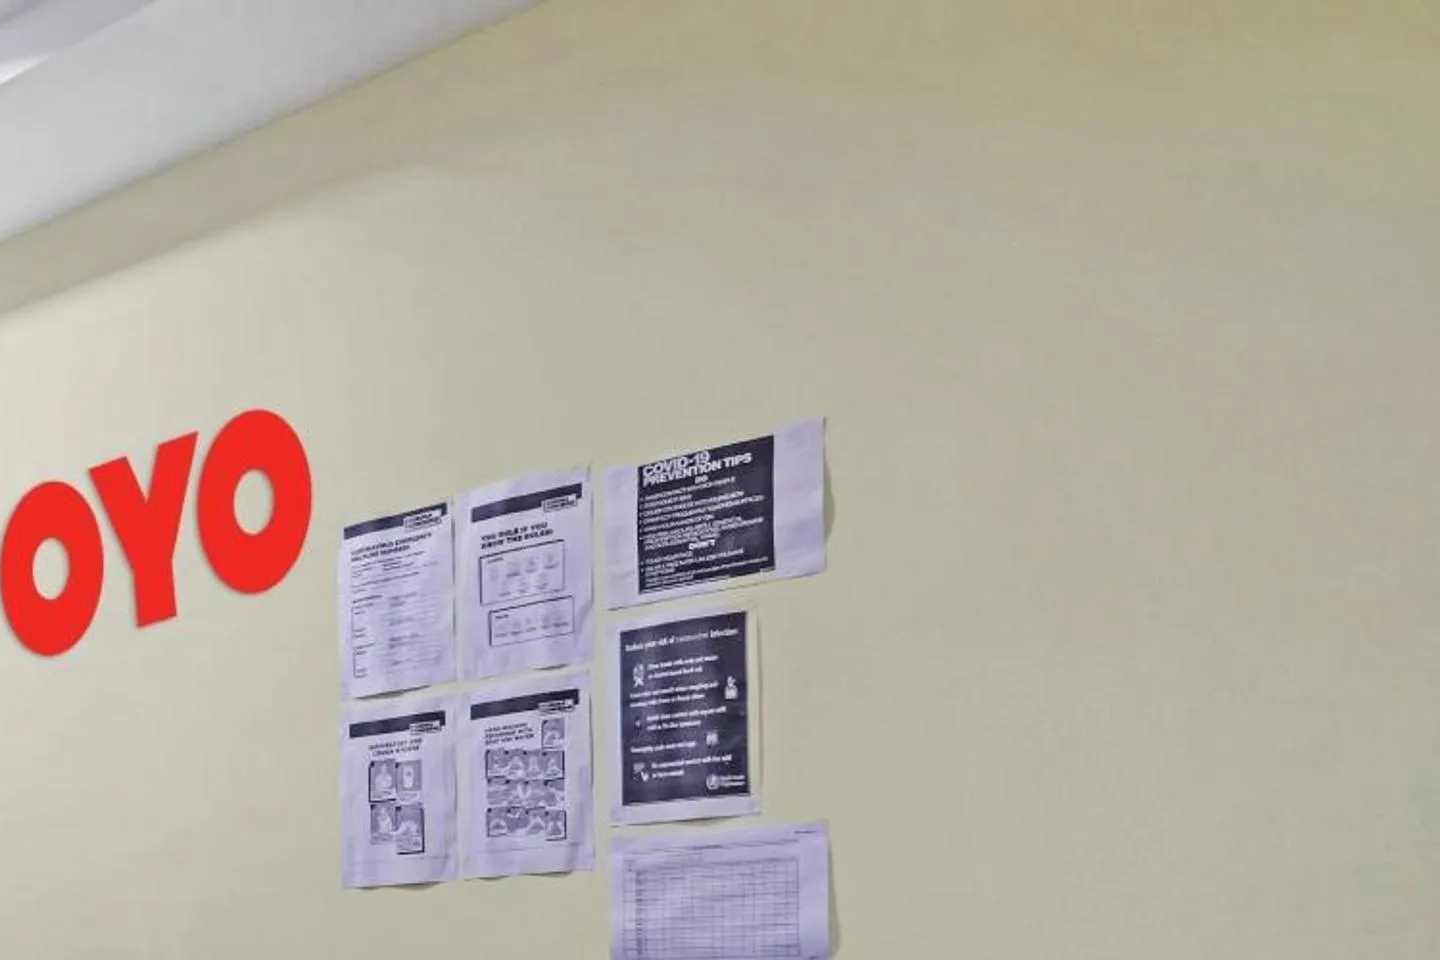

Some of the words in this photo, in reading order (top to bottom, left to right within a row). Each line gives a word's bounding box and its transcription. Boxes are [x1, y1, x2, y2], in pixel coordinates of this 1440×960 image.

[643, 450, 710, 478] COVID-19
[643, 460, 721, 487] PREVENTION
[723, 452, 752, 469] TIPS
[0, 408, 313, 657] OYO
